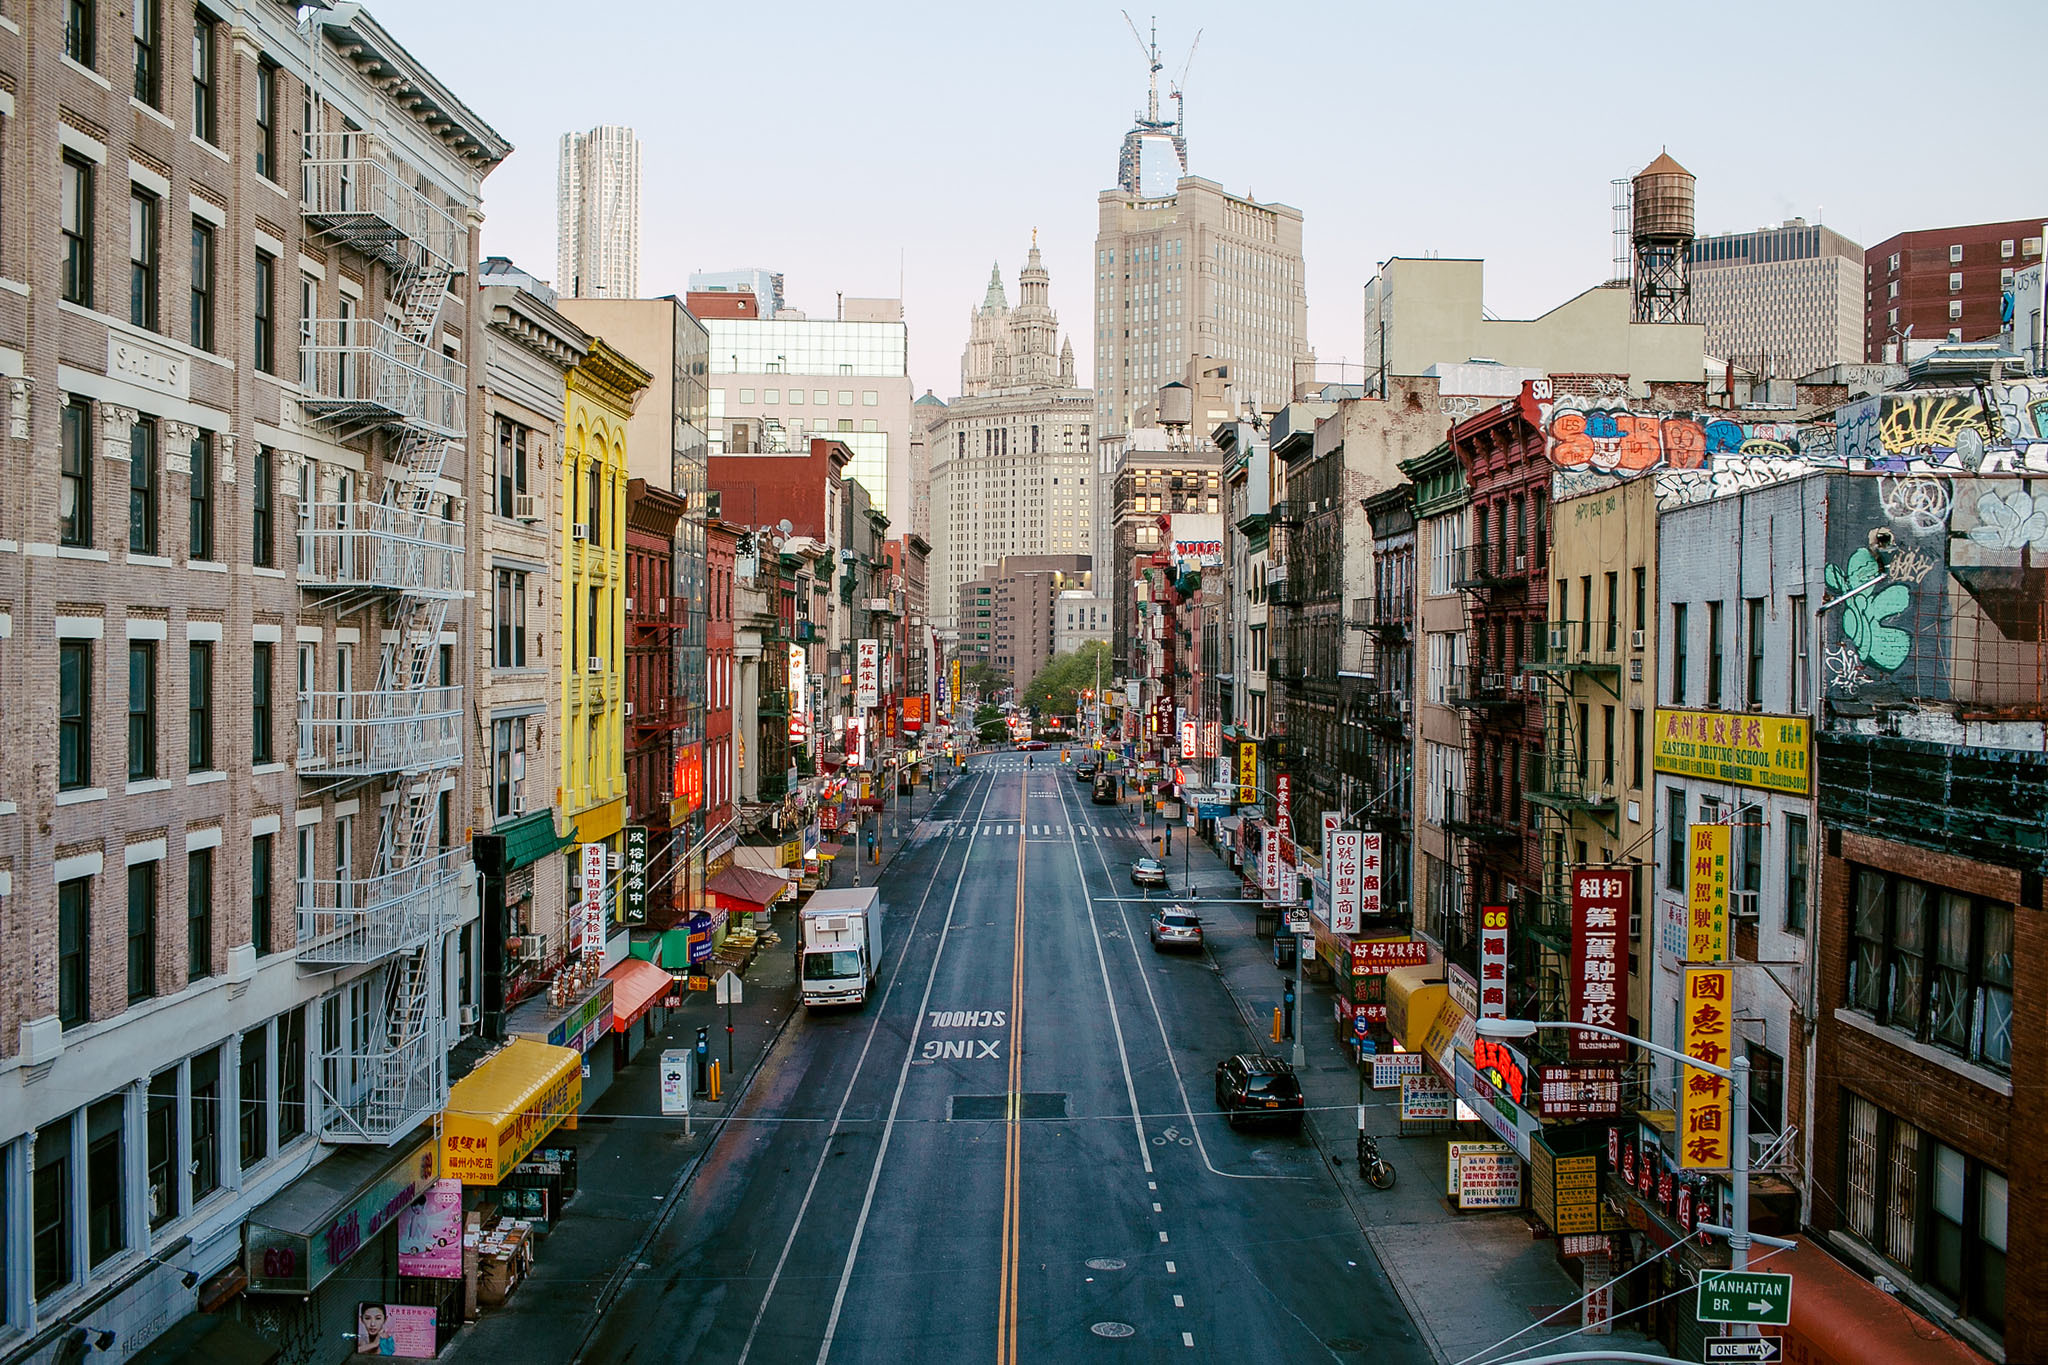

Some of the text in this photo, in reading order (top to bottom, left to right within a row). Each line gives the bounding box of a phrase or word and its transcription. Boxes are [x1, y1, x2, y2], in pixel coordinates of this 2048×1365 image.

[1662, 740, 1770, 767] EASTERN DRIVING SCHOOL
[1579, 878, 1622, 899] 紐約
[1693, 830, 1713, 962] 廣州駕駛學
[1484, 911, 1507, 928] 66
[1581, 907, 1617, 1026] 第一駕駛學校
[1483, 937, 1505, 1019] 福宝商
[928, 1010, 1006, 1028] SCHOOL
[922, 1040, 1001, 1059] XING
[1491, 1069, 1503, 1089] 66
[448, 1157, 494, 1169] 福州小吃店
[1708, 1280, 1782, 1295] MANHATTAN
[1713, 1298, 1733, 1312] BR.
[1716, 1345, 1770, 1355] ONE WAY
